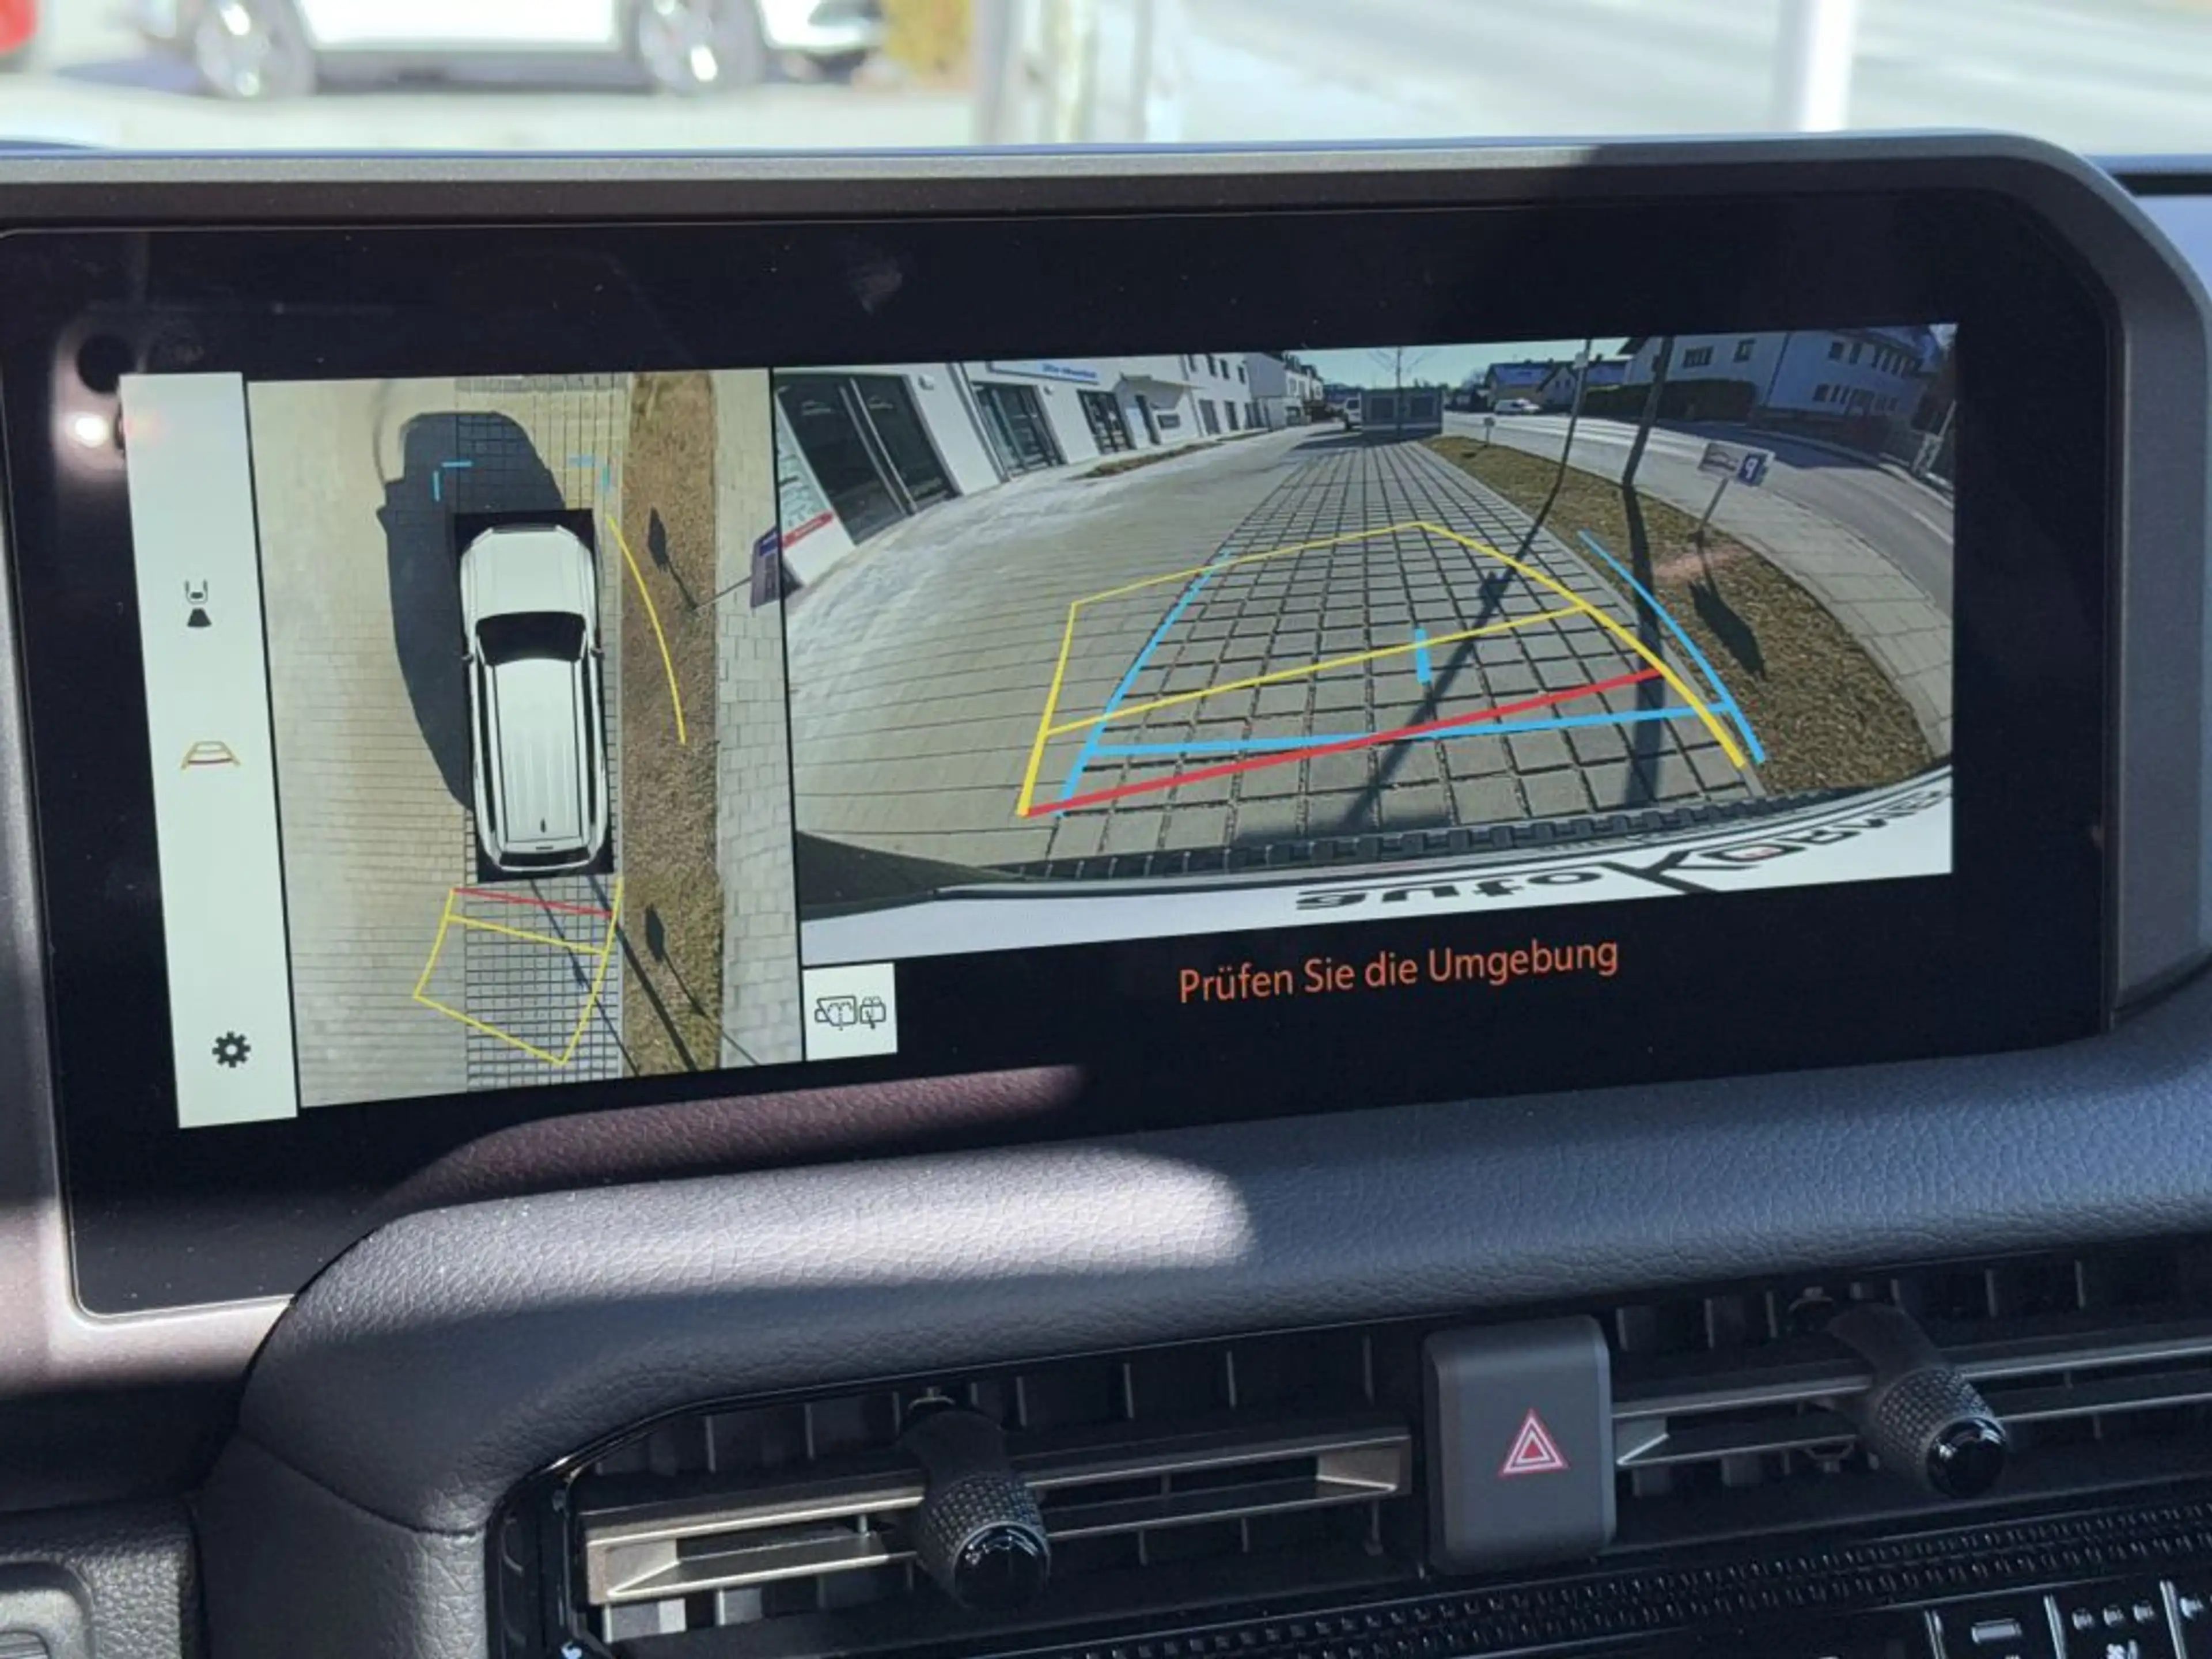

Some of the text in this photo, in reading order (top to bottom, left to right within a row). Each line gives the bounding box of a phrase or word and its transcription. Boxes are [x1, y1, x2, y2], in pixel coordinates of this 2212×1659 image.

[1180, 938, 1619, 1003] Prüfen Sie die Umgebung
